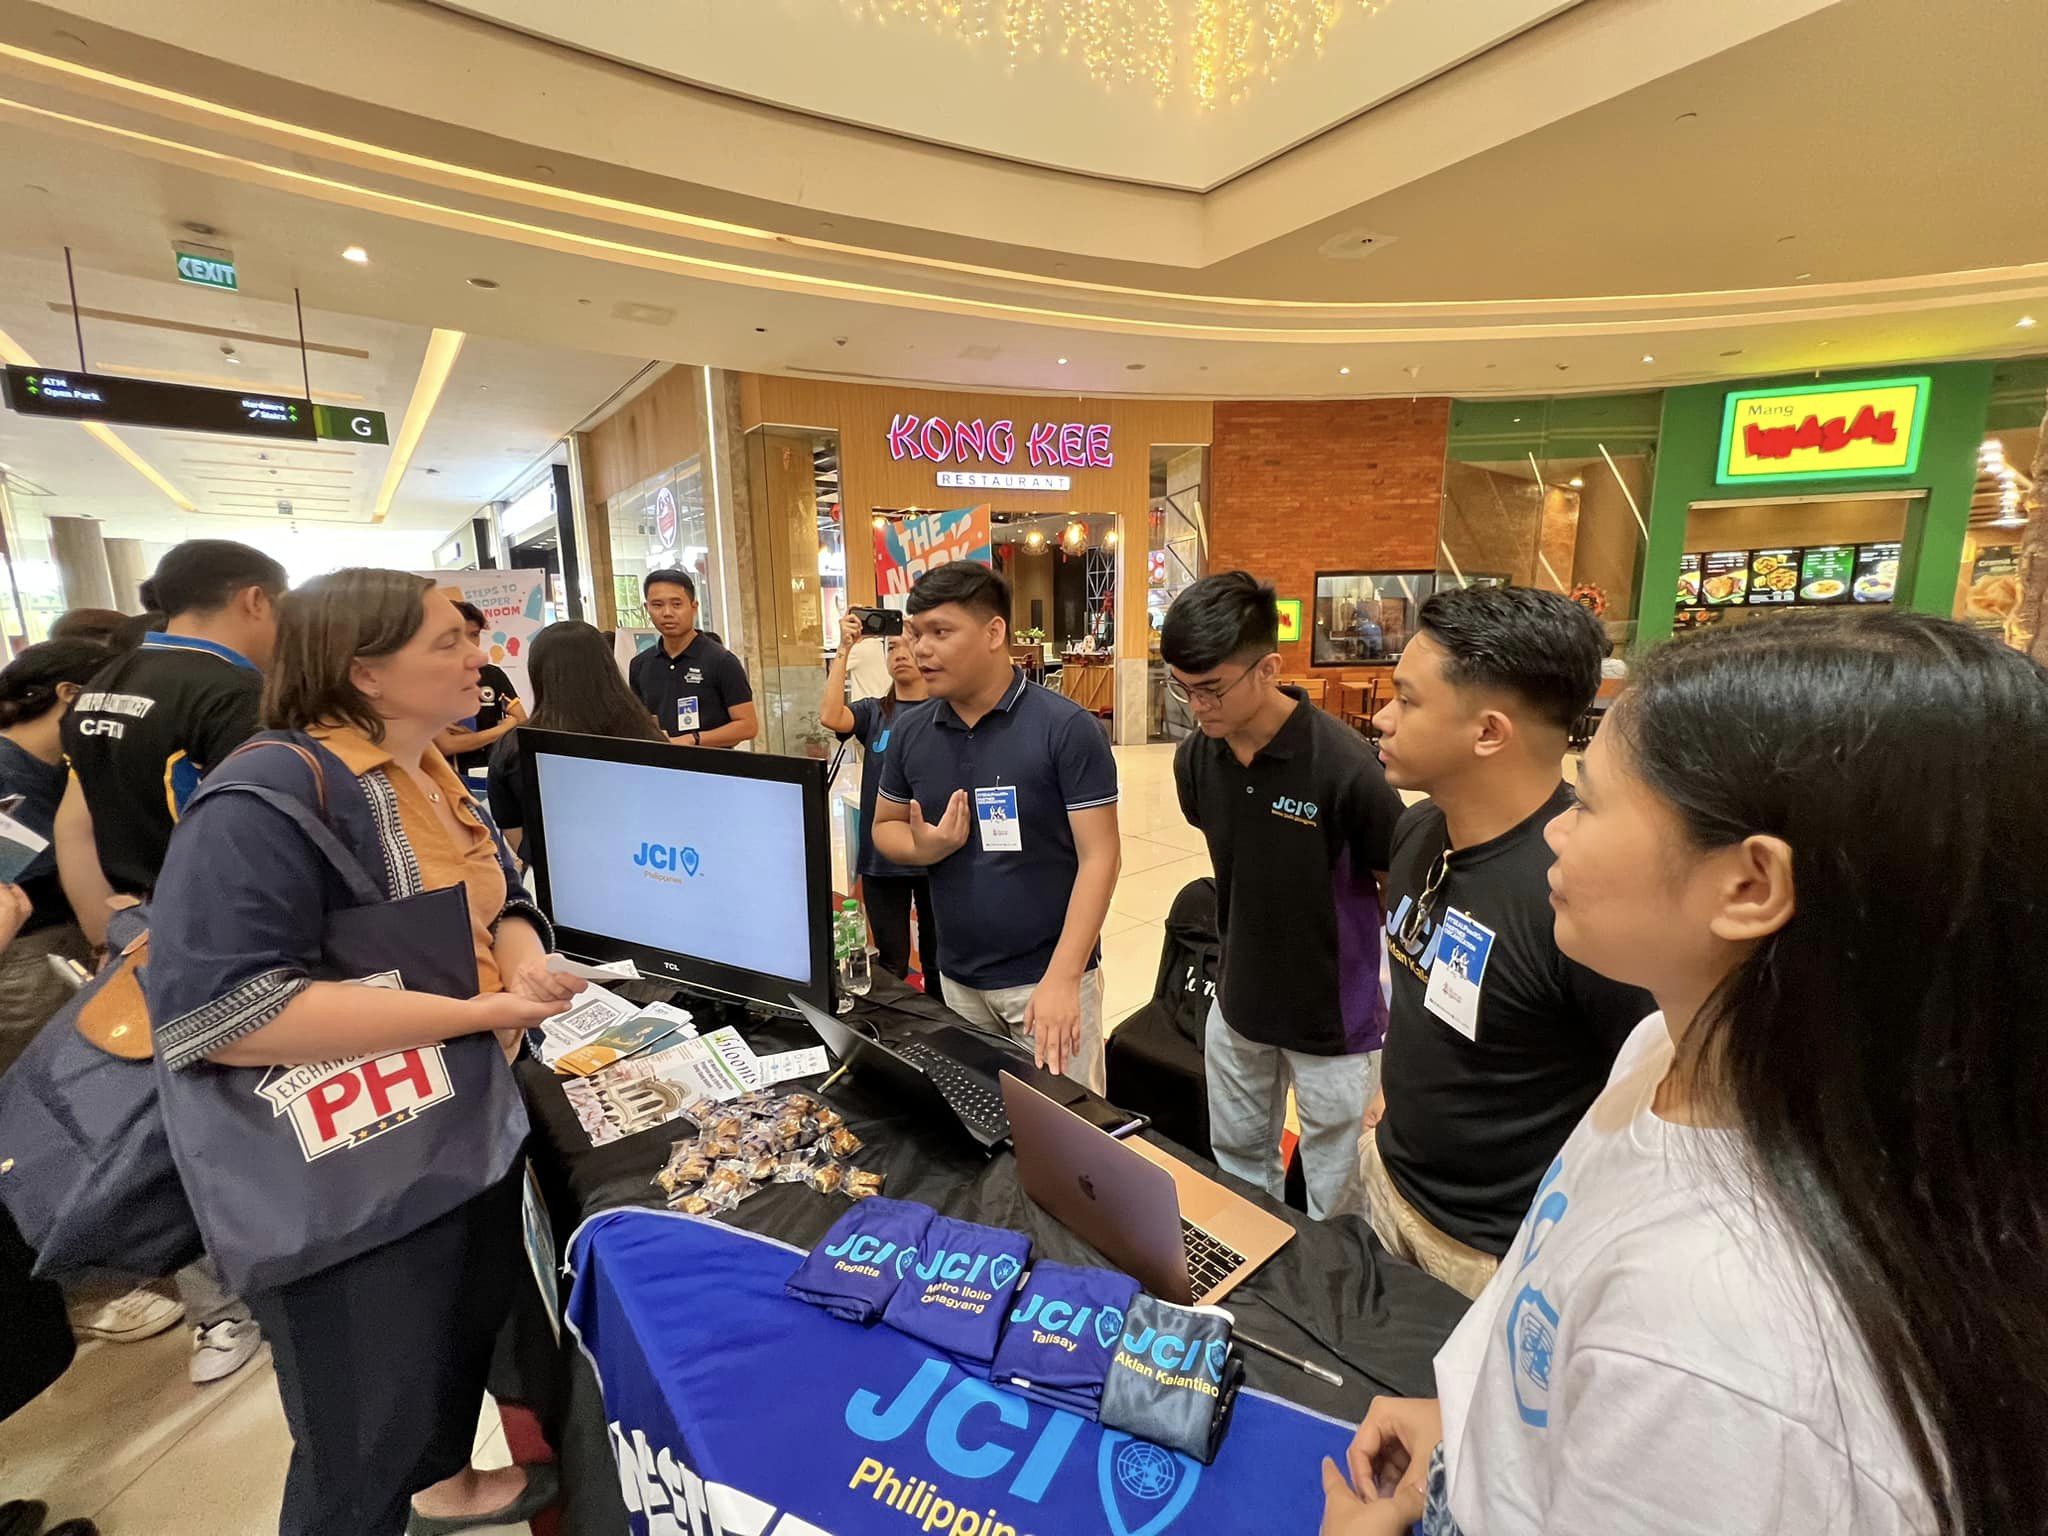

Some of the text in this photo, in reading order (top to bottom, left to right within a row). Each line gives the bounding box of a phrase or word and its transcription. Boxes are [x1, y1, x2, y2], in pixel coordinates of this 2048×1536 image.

[191, 259, 234, 285] EXIT
[1748, 404, 1794, 417] Mang
[351, 417, 372, 436] G
[886, 414, 1113, 467] KONG KEE
[941, 474, 1066, 488] RESTAURANT
[898, 513, 945, 562] THE
[465, 583, 517, 599] STEPS TO
[1272, 796, 1303, 816] JCI
[633, 842, 676, 871] JCI
[663, 961, 680, 971] TCL
[305, 1049, 433, 1143] PH
[825, 1234, 897, 1264] JCI
[834, 1261, 880, 1278] Regatta
[915, 1250, 989, 1283] JCI
[961, 1286, 993, 1301] Iloilo
[1010, 1295, 1092, 1337] JCI
[1032, 1330, 1078, 1352] Talisay
[1123, 1326, 1201, 1371] JCI
[1114, 1351, 1220, 1398] Aklan Kalantiao
[845, 1357, 1087, 1504] JCI
[848, 1456, 1033, 1536] Philippin
